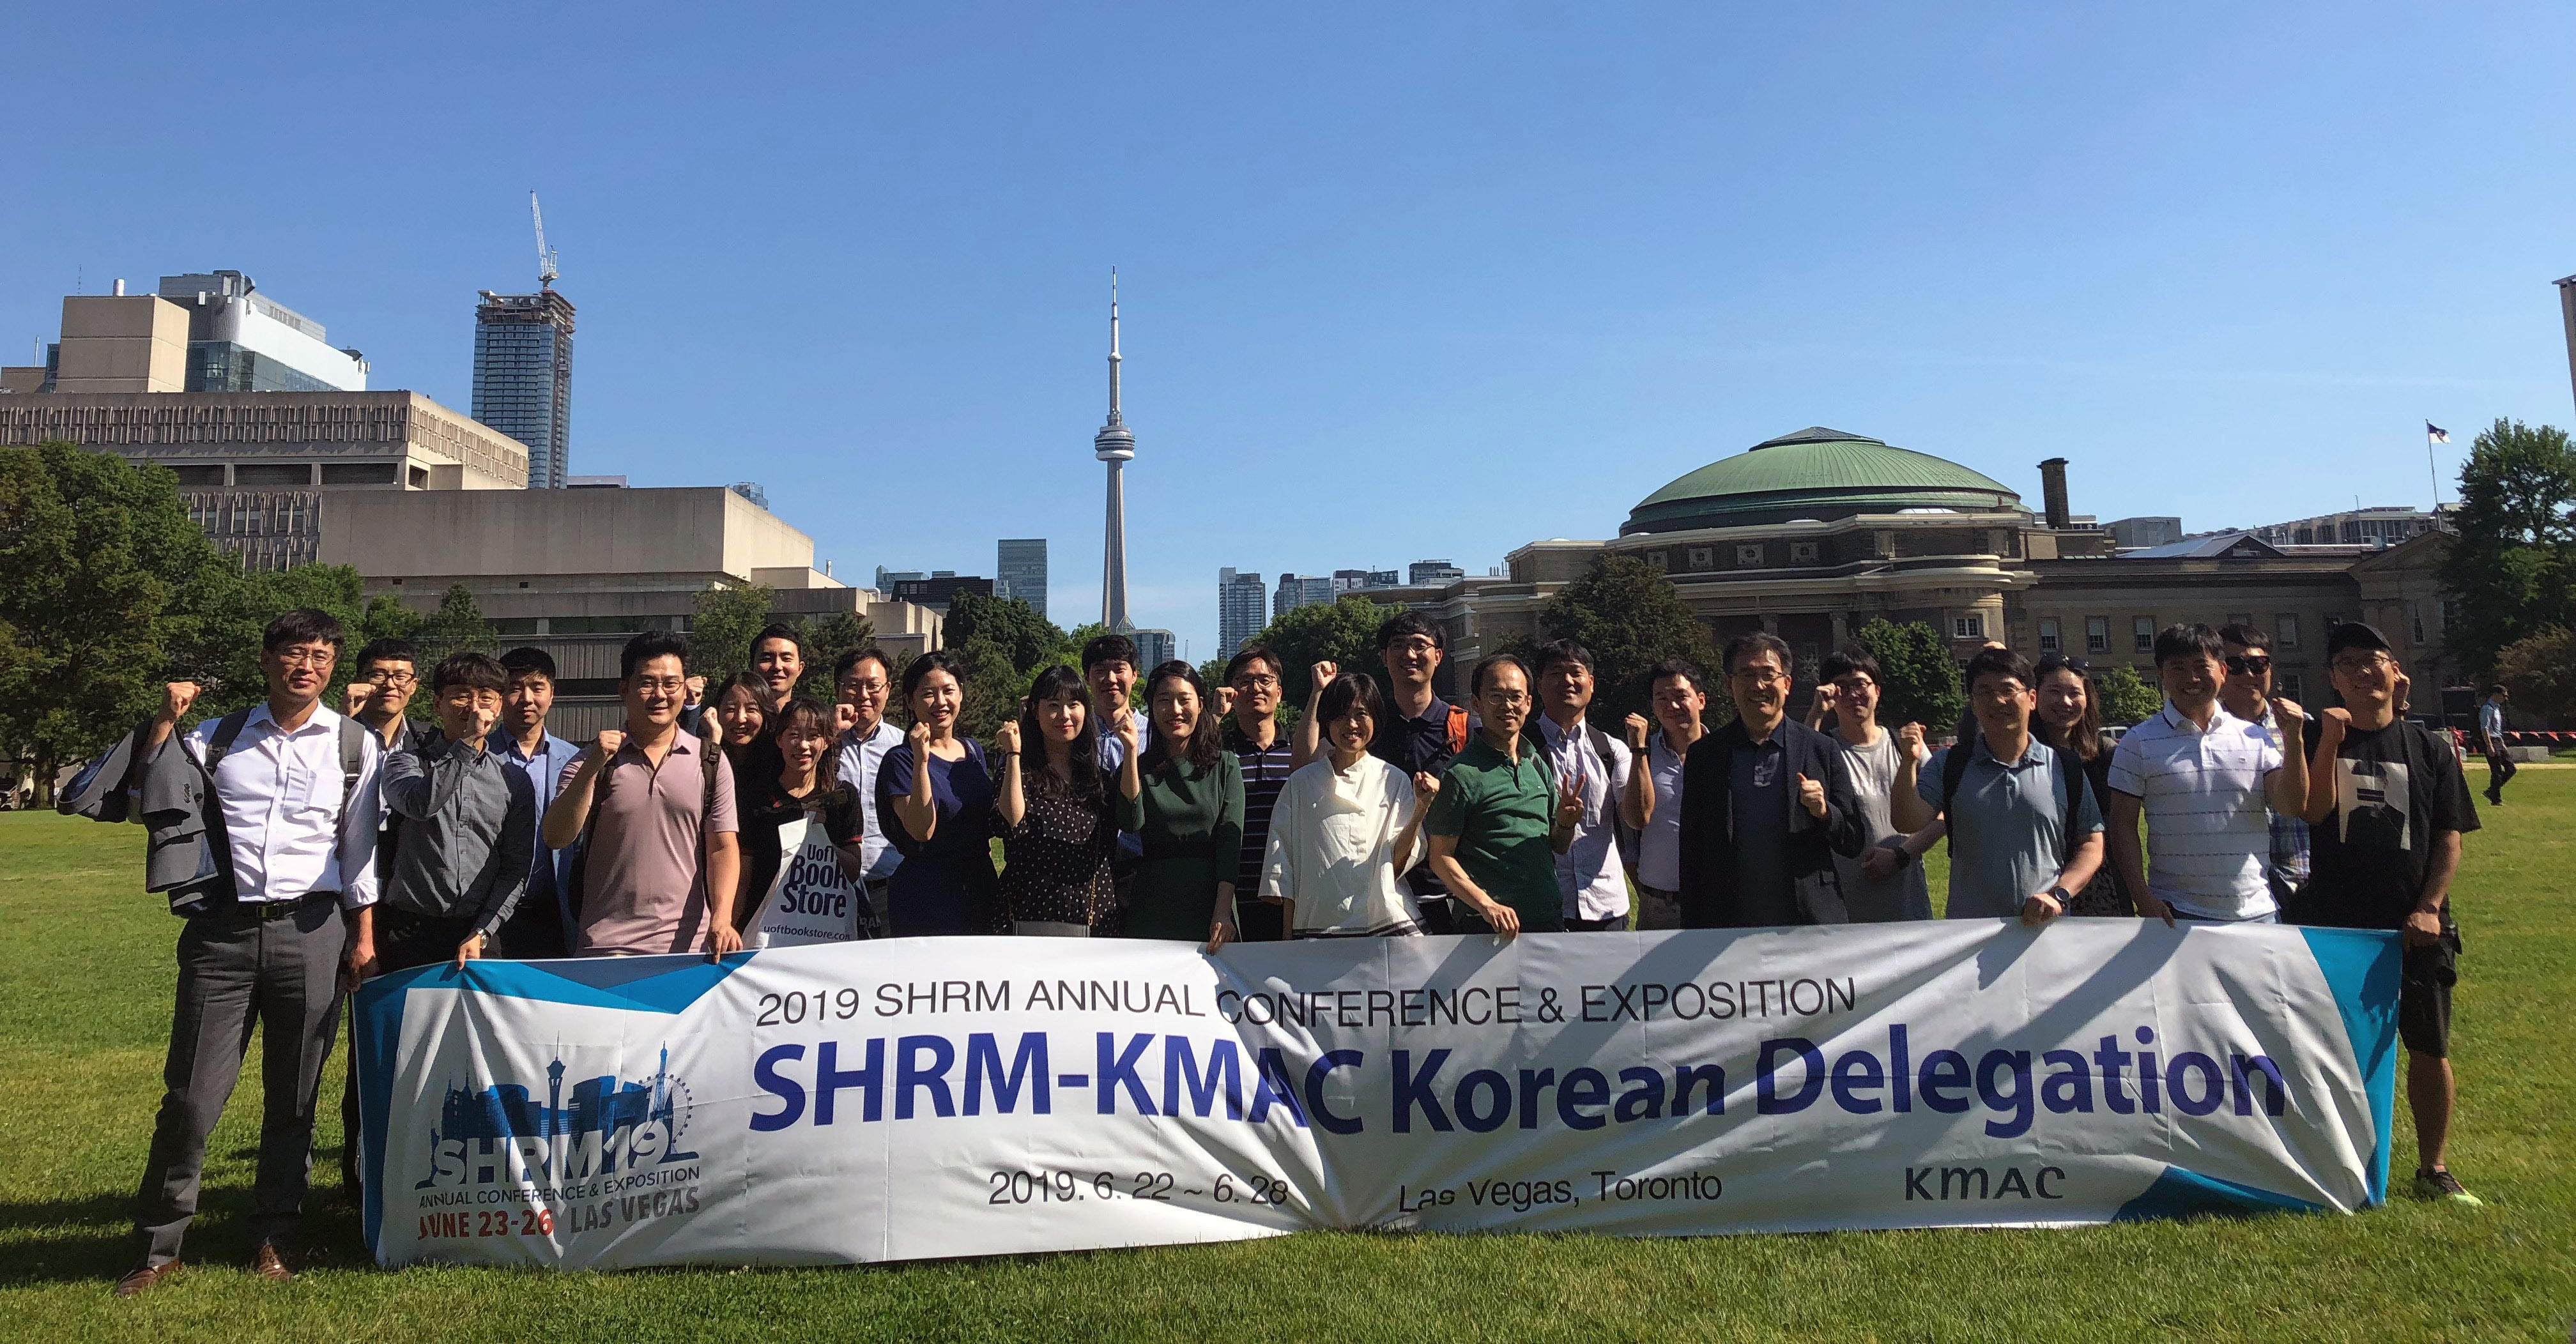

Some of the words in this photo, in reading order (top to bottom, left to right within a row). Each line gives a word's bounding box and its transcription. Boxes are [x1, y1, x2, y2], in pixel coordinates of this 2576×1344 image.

[780, 882, 847, 918] Store
[756, 988, 859, 1027] 2019
[875, 980, 1011, 1018] SHRM
[1025, 979, 1206, 1018] ANNUAL
[1216, 986, 1521, 1028] CONFERENCE
[1539, 987, 1565, 1023] &
[1581, 976, 1856, 1022] EXPOSITION
[749, 1031, 1364, 1135] SHRM-KMAC
[1392, 1048, 1726, 1134] Korean
[1756, 1023, 2287, 1139] Delegation
[434, 1122, 670, 1188] SHRM19
[419, 1191, 473, 1209] ANNUAL
[477, 1186, 585, 1205] CONFERENCE
[589, 1183, 599, 1197] &
[604, 1166, 700, 1194] EXPOSITION
[1132, 1172, 1174, 1200] 22
[1399, 1184, 1457, 1213] Las
[1467, 1178, 1580, 1213] Vegas,
[1590, 1170, 1722, 1201] Toronto
[418, 1211, 470, 1241] JUNE
[477, 1209, 554, 1237] 23-26
[571, 1200, 613, 1233] LAS
[621, 1186, 700, 1223] VEGAS
